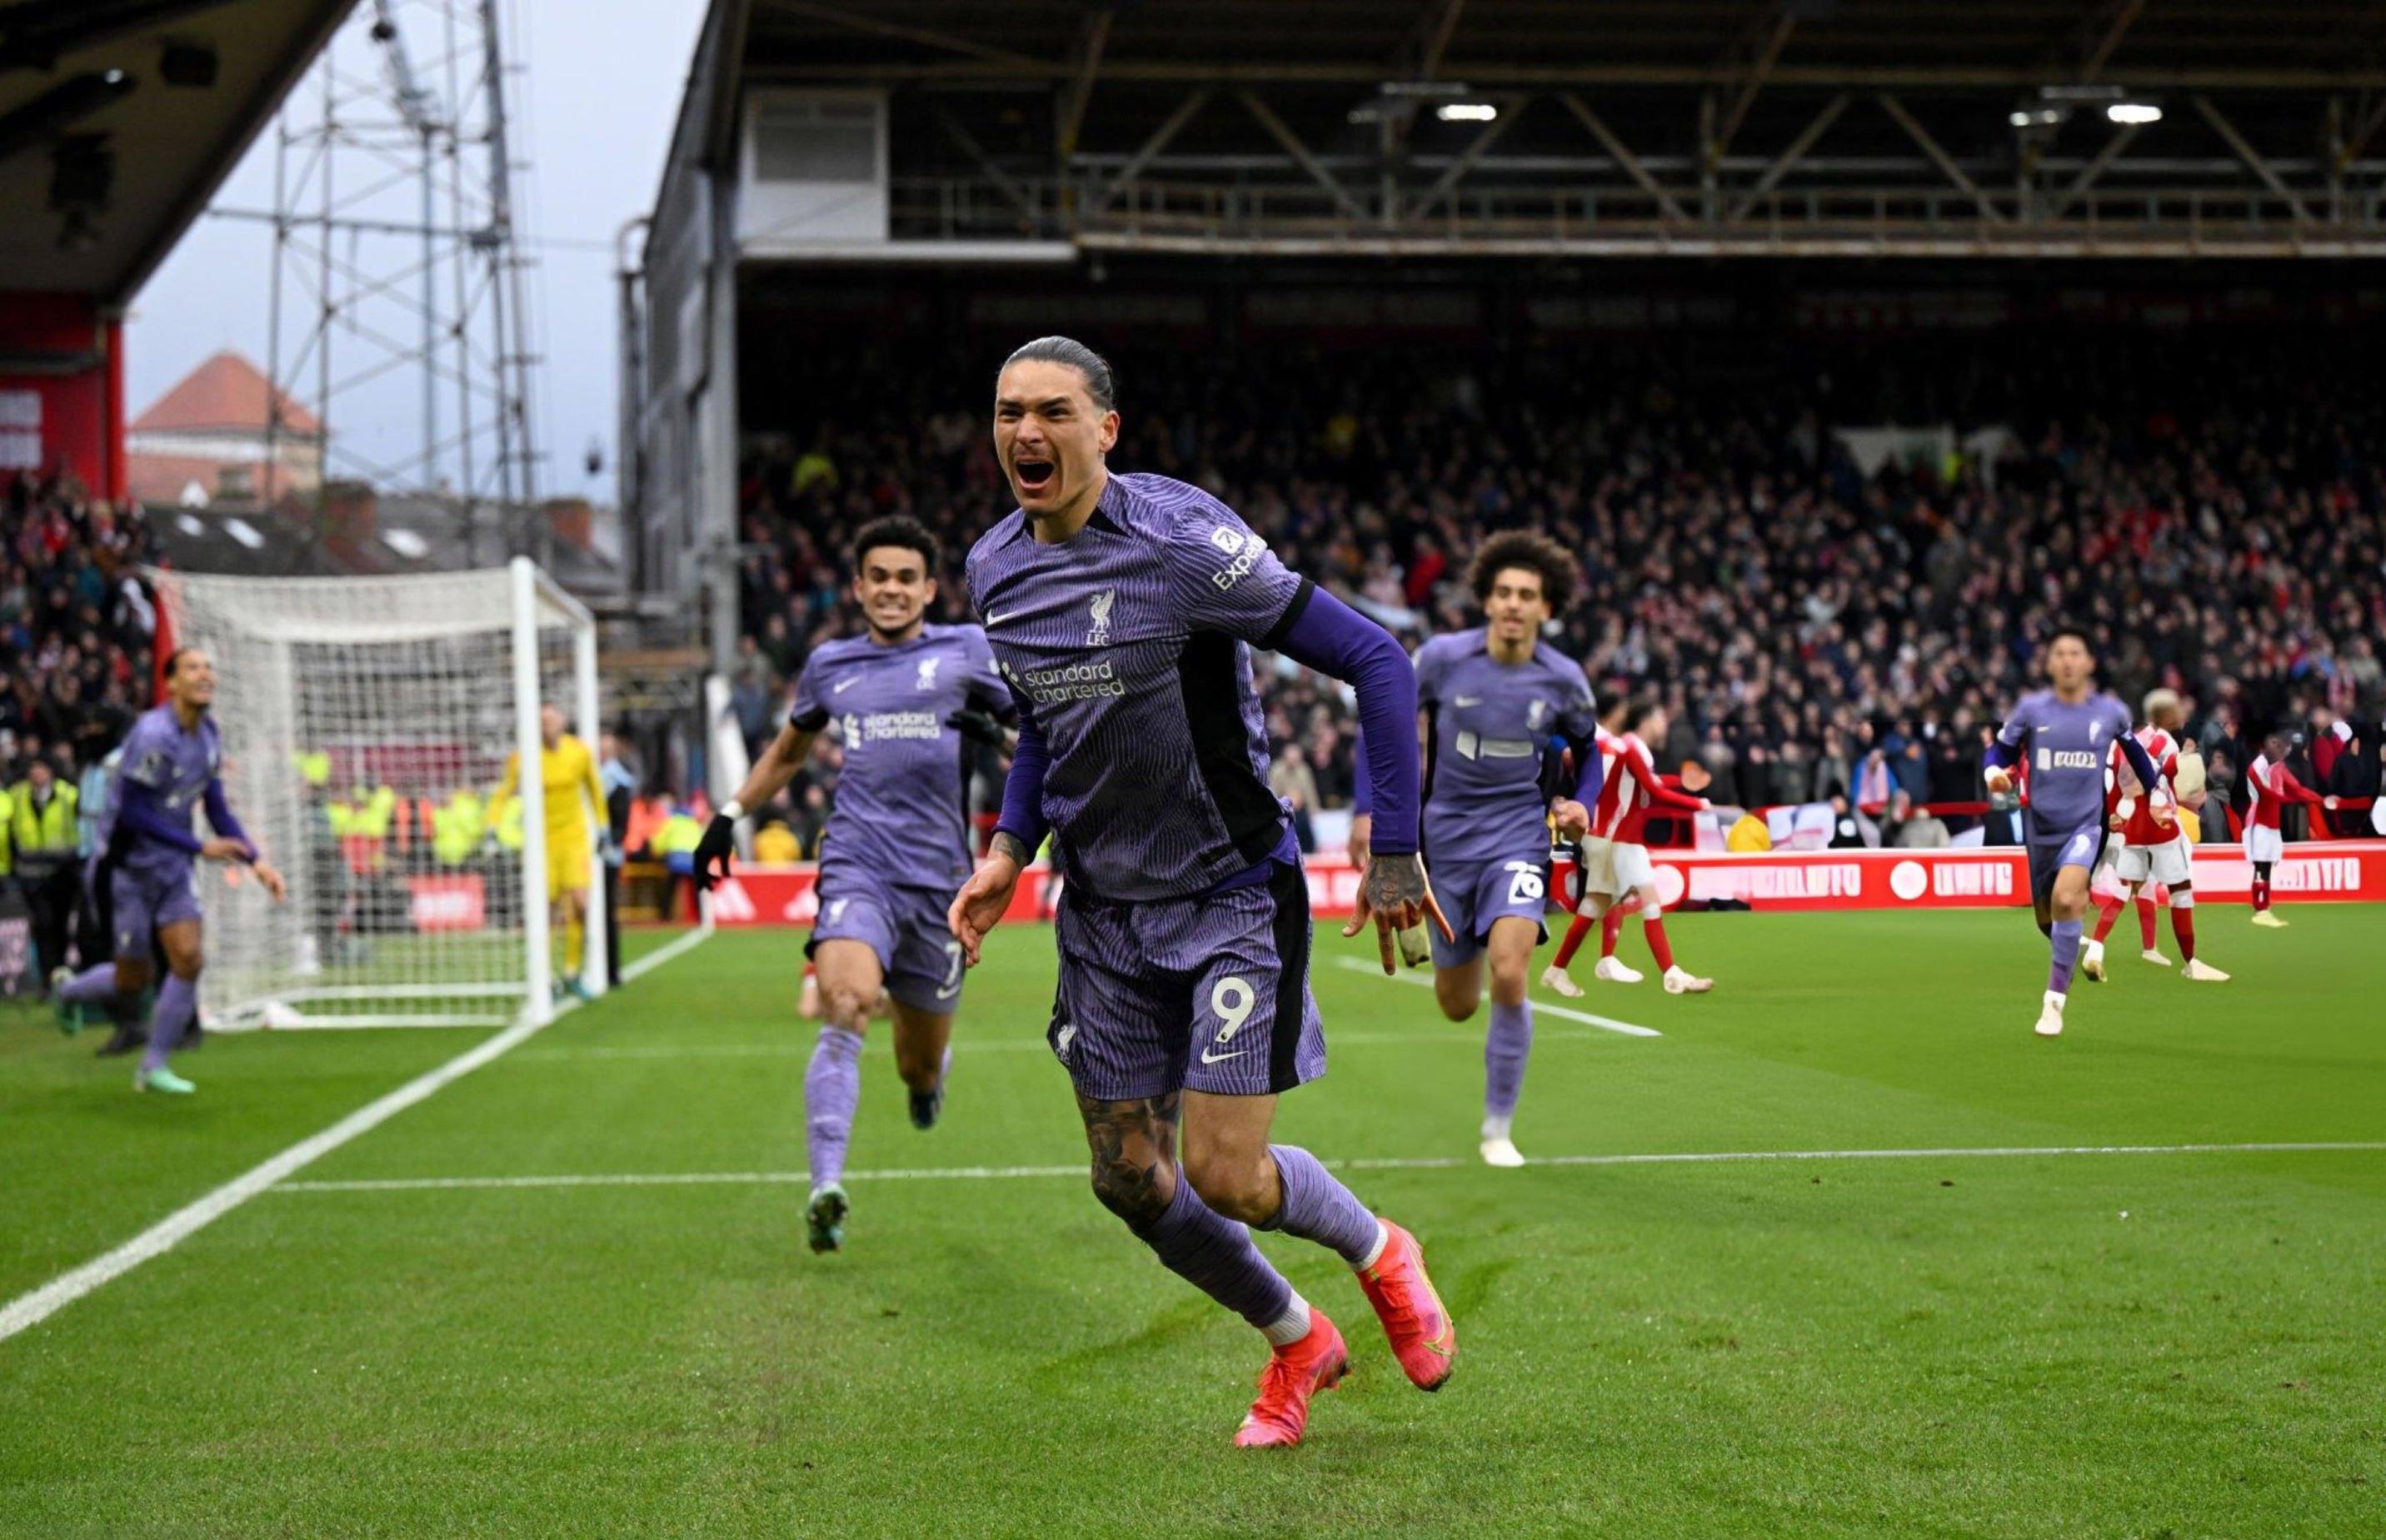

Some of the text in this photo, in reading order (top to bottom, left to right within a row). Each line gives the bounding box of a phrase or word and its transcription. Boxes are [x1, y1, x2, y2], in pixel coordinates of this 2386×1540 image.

[1086, 633, 1110, 646] LFC
[1025, 660, 1113, 687] standard
[1033, 678, 1125, 703] chartered
[944, 940, 962, 986] 7
[1211, 977, 1255, 1043] 9
